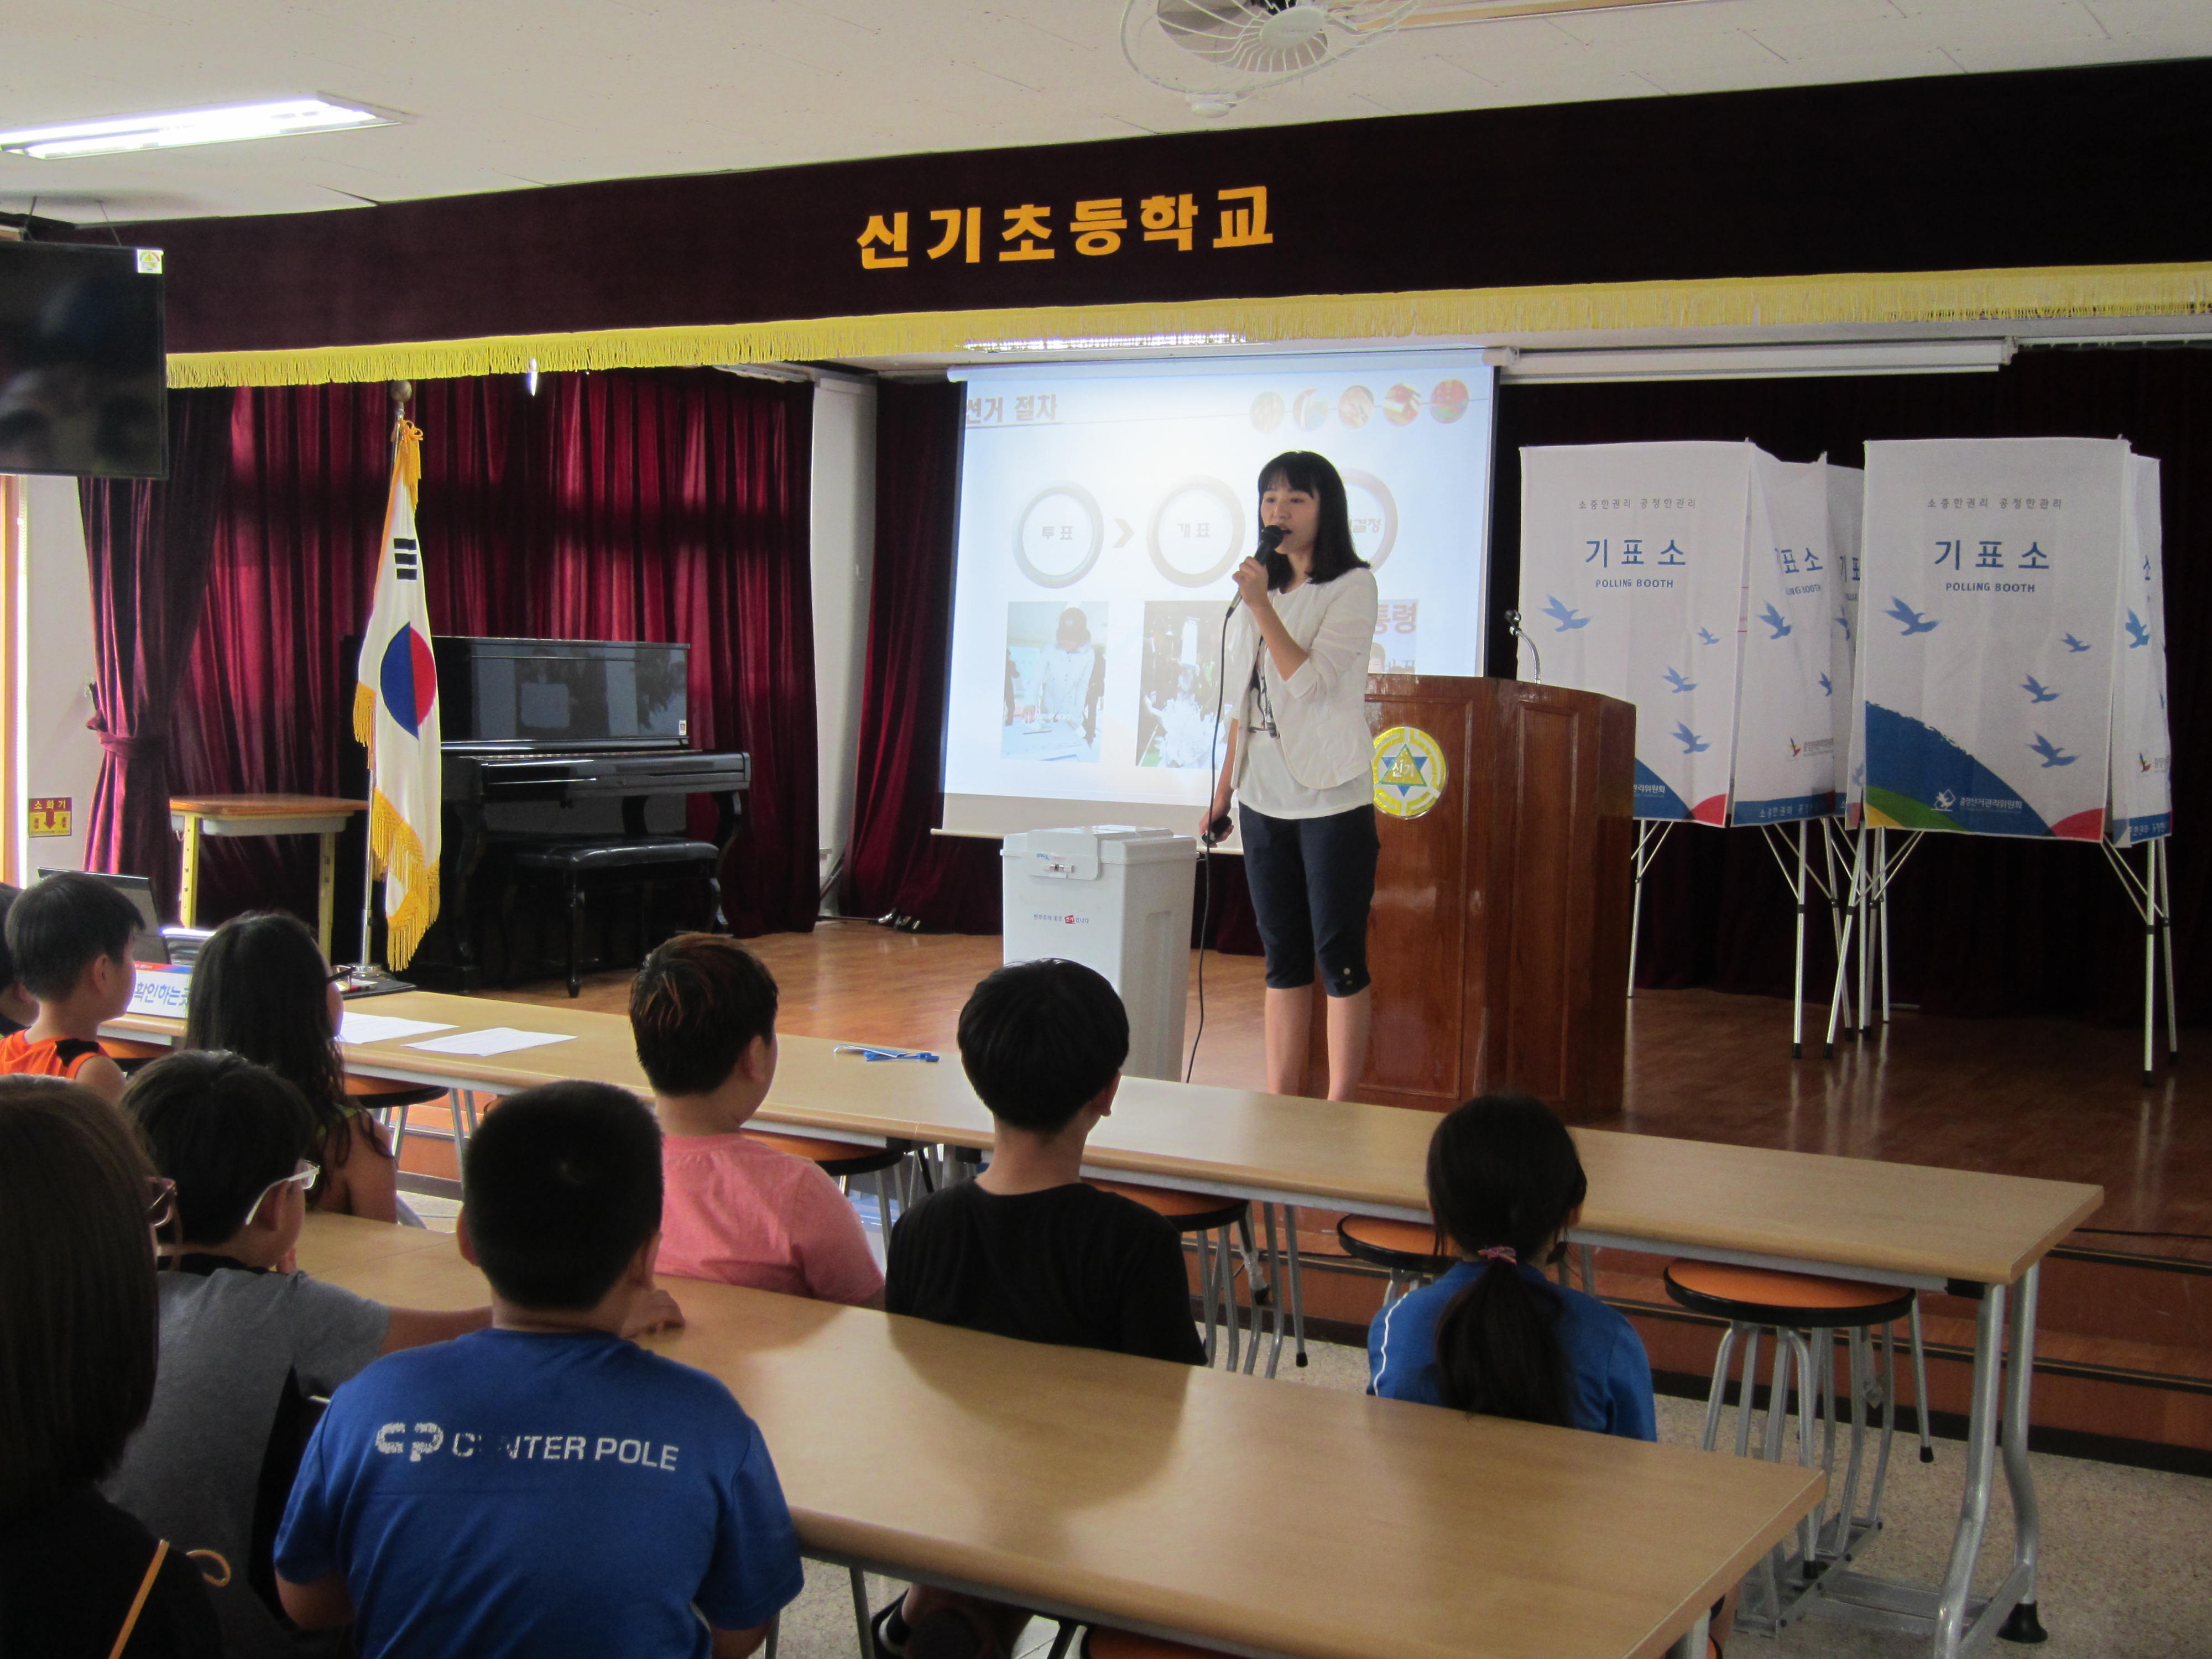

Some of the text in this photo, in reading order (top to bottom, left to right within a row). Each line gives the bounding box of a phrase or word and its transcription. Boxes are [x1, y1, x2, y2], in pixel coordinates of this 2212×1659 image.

[857, 186, 1273, 269] 신기초등학교
[1015, 394, 1057, 421] 절차
[1042, 526, 1073, 540] 투표
[1177, 523, 1210, 538] 개표
[1349, 518, 1381, 533] 결정
[1585, 539, 1686, 568] 기표소
[1775, 547, 1823, 573] 표소
[1934, 540, 2049, 570] 기표소
[1596, 580, 1632, 588] POLLING
[1945, 582, 2035, 593] POLLING BOOTH
[1375, 602, 1417, 634] 통령
[1392, 759, 1415, 778] 신기
[34, 800, 66, 810] 소화기
[452, 1432, 585, 1460] CNTER
[594, 1437, 679, 1472] POLE
